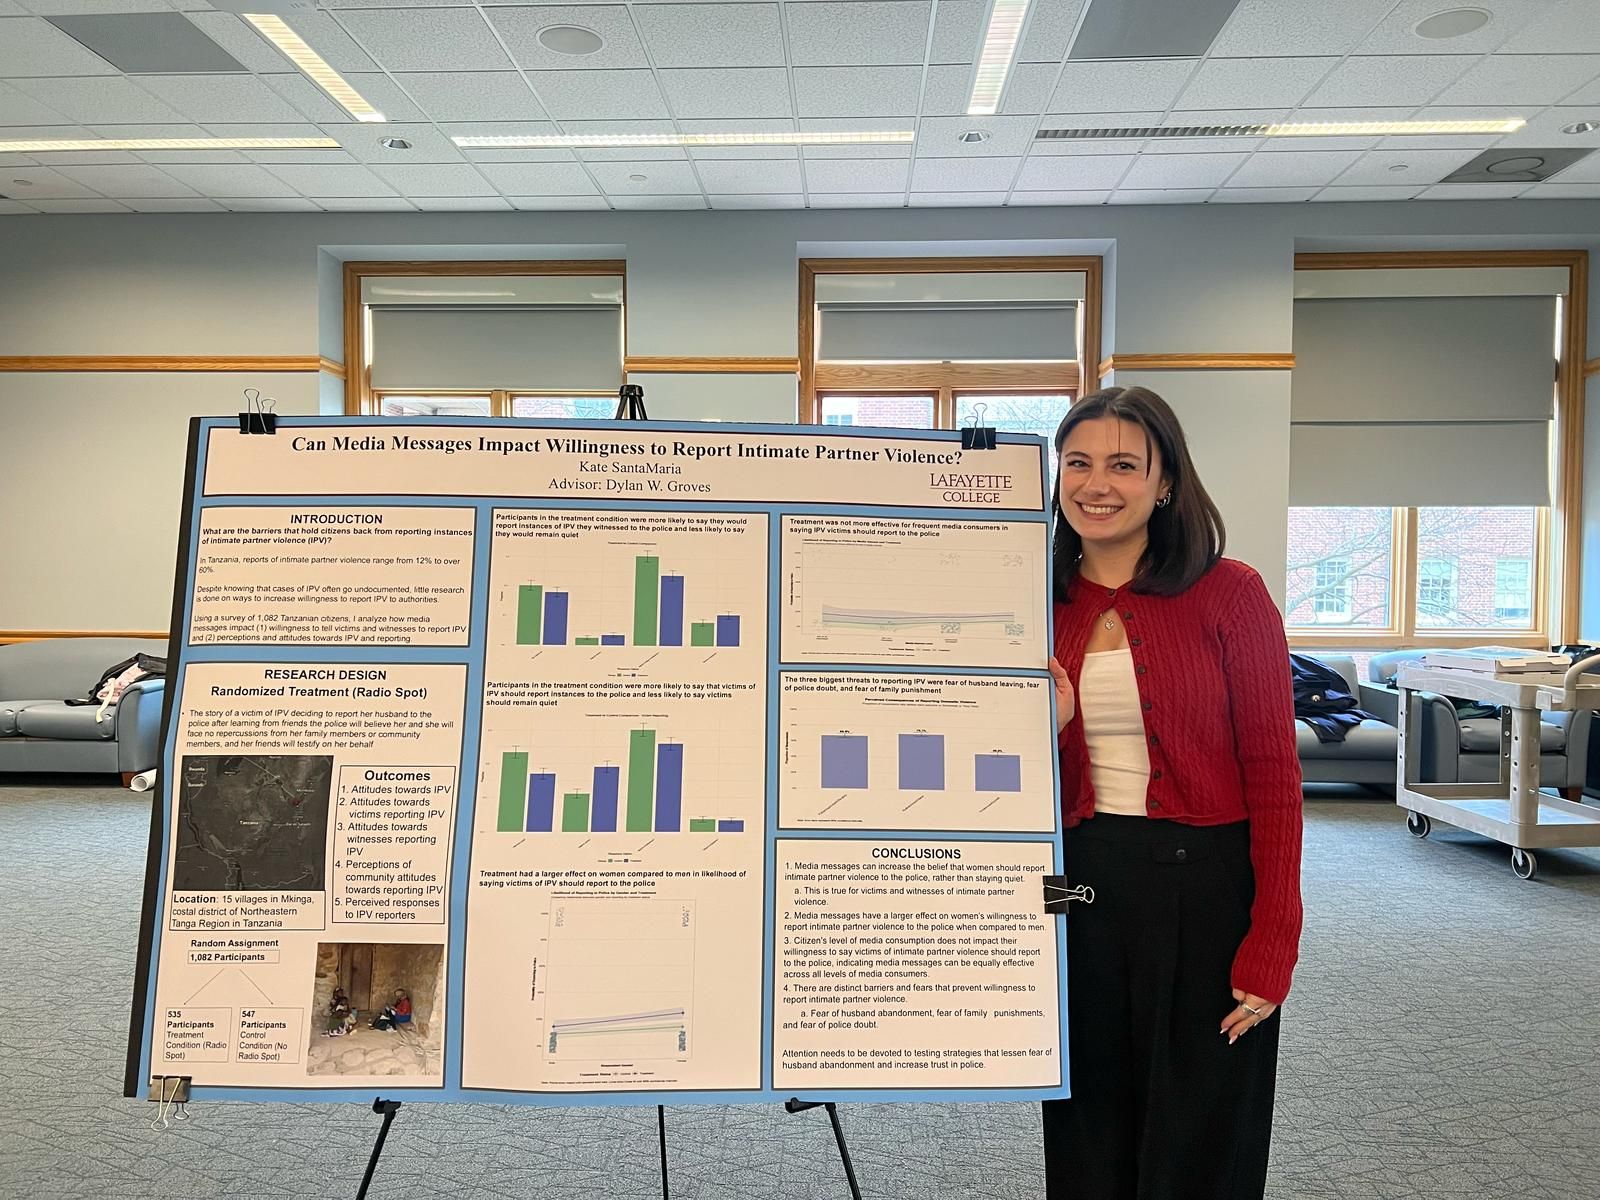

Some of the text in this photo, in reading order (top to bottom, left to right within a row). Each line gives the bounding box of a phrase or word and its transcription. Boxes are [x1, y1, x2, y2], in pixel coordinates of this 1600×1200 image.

[292, 436, 962, 465] Can Media Messages Impact Willingness to Report Intimate Partner Violence?
[579, 461, 682, 474] Kate SantaMaria
[548, 478, 711, 493] Advisor: Dylan W. Groves
[930, 473, 1013, 489] LAFAYETTE
[942, 492, 1000, 503] COLLEGE
[290, 514, 384, 524] INTRODUCTION
[394, 528, 432, 536] reporting
[264, 669, 387, 680] RESEARCH DESIGN
[211, 685, 428, 700] Randomized Treatment (Radio Spot)
[900, 686, 942, 694] punishment
[296, 740, 320, 749] testify
[364, 770, 431, 780] Outcomes
[341, 785, 451, 794] 1. Attitudes towards IPV
[339, 797, 430, 806] 2. Attitudes towards
[349, 809, 446, 820] victims reporting IPV
[337, 822, 428, 831] 3. Attitudes towards
[346, 834, 437, 845] witnesses reporting
[346, 847, 364, 856] IPV
[872, 848, 962, 859] CONCLUSIONS
[335, 860, 412, 870] 4. Perceptions of
[345, 872, 436, 883] community attitudes
[541, 870, 563, 878] larger
[626, 870, 664, 878] compared
[345, 885, 444, 896] towards reporting IPV
[987, 888, 1015, 897] partner
[173, 894, 218, 903] Location:
[222, 895, 232, 903] 15
[234, 894, 268, 905] villages
[270, 894, 278, 903] in
[335, 897, 440, 909] 5. Perceived responses
[172, 906, 298, 916] costal district of Northeastern
[345, 910, 416, 921] to IPV reporters
[172, 918, 283, 929] Tanga Region in Tanzania
[227, 939, 279, 948] Assignment
[190, 952, 265, 962] 1,082 Participants
[783, 996, 807, 1005] report
[842, 995, 871, 1004] partner
[167, 1020, 215, 1030] Participants
[240, 1021, 287, 1030] Participants
[202, 1041, 227, 1050] (Radio
[274, 1042, 288, 1051] (No
[165, 1051, 186, 1060] Spot)
[260, 1052, 280, 1061] Spot)
[876, 1060, 892, 1068] and
